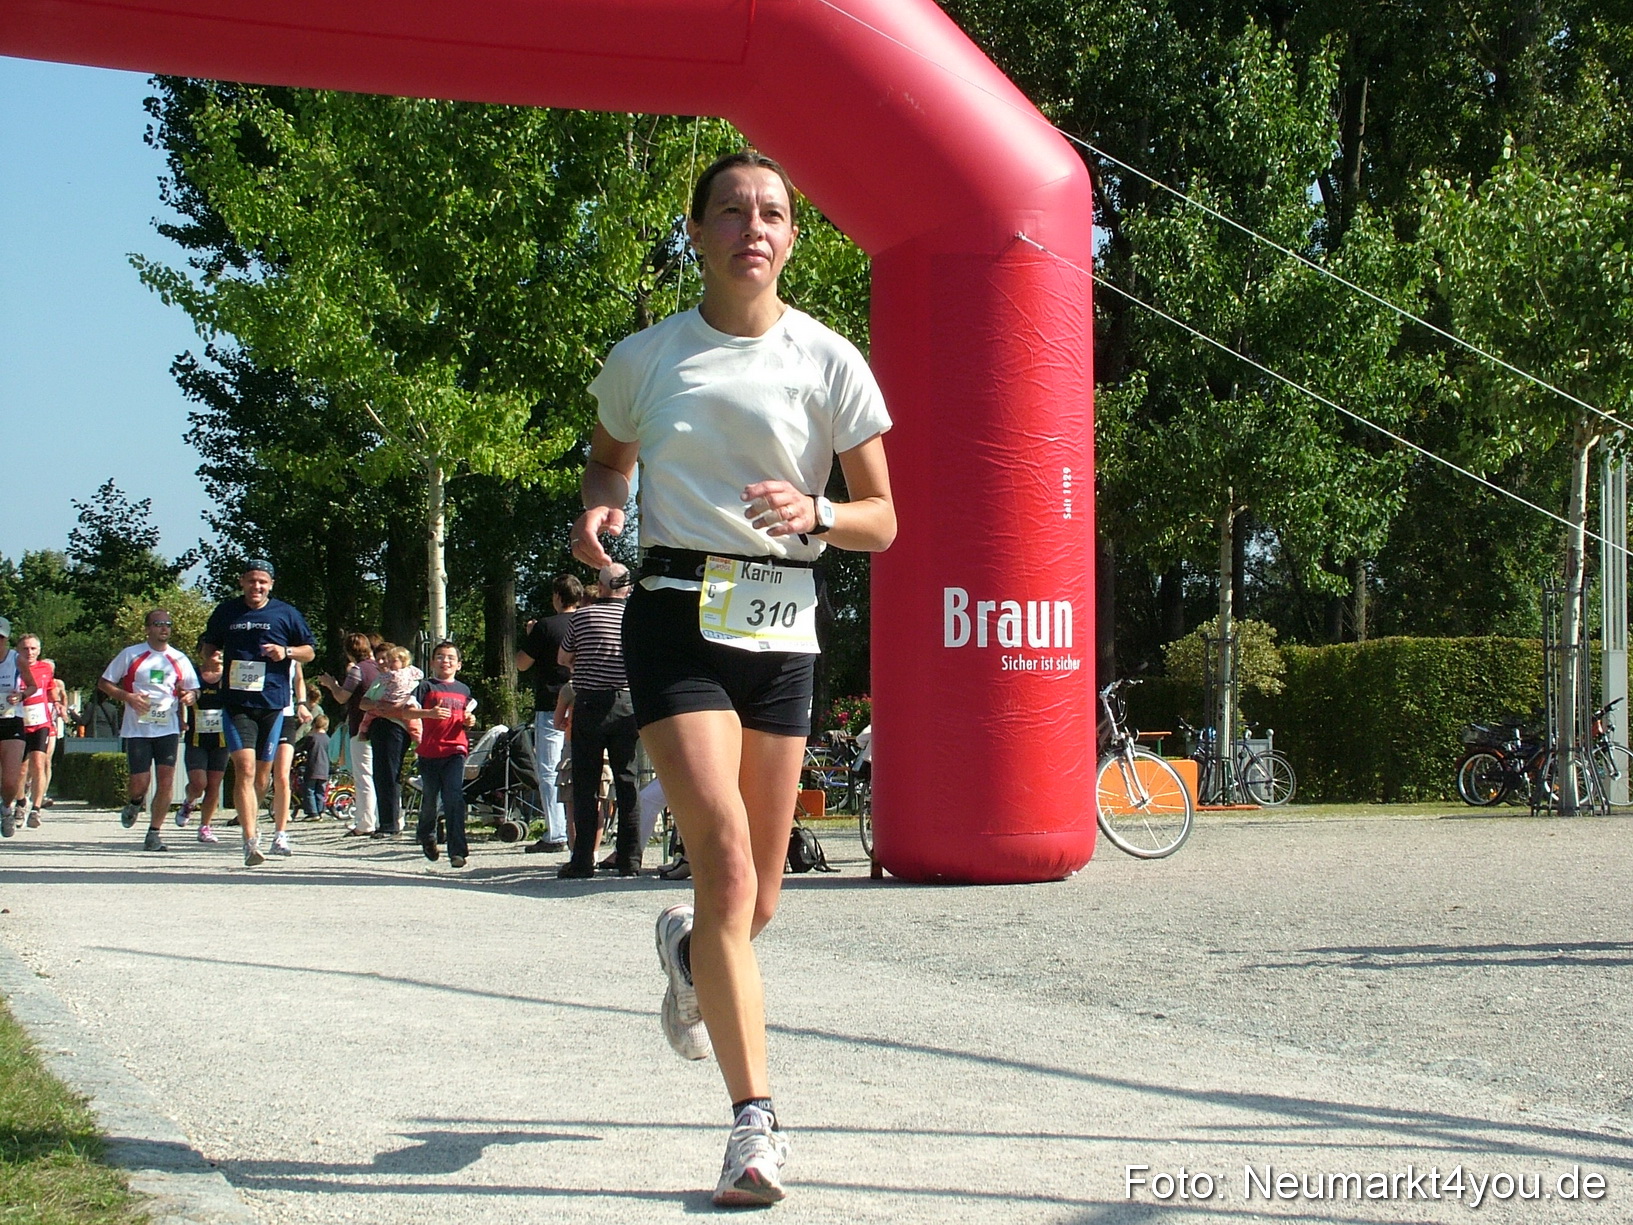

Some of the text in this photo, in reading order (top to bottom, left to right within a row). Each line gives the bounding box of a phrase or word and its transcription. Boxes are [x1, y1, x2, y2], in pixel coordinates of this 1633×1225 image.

[1063, 466, 1071, 494] 1929
[741, 562, 783, 584] Karin
[708, 584, 717, 599] C
[746, 599, 797, 628] 310
[944, 587, 1073, 648] Braun
[1002, 653, 1081, 671] Sicher ist sicher
[241, 673, 259, 682] 288
[151, 710, 166, 718] 955
